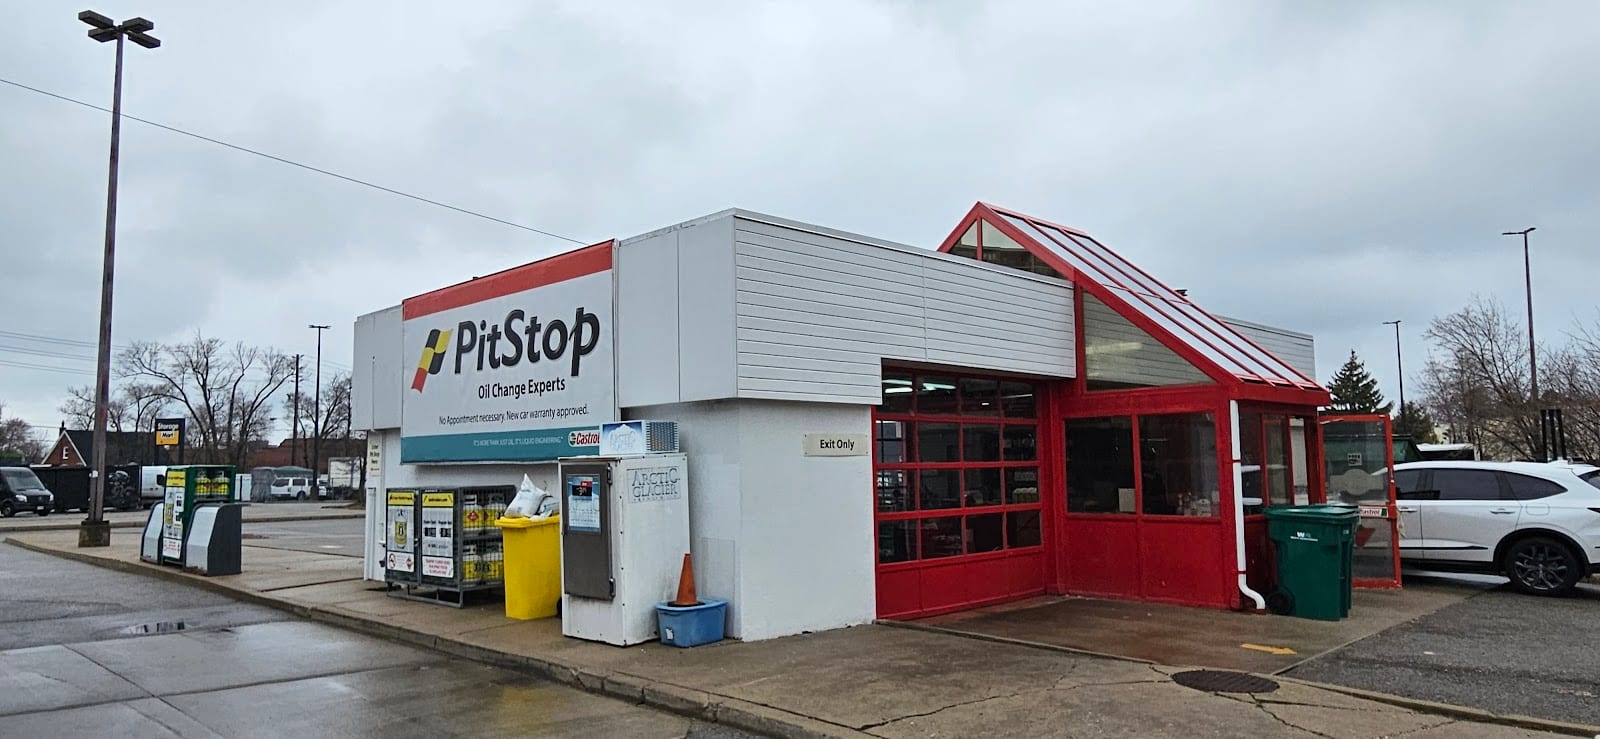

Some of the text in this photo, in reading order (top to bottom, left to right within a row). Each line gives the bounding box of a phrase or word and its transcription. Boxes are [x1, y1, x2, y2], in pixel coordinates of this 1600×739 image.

[454, 307, 600, 377] PitStop
[478, 377, 566, 400] Oil Change Experts
[439, 415, 446, 425] No
[447, 415, 479, 426] Appointment
[506, 410, 519, 420] New
[520, 410, 529, 420] car
[530, 408, 556, 420] warranty
[556, 404, 589, 419] approved.
[157, 422, 179, 431] Storage
[820, 439, 855, 451] Exit Only
[631, 467, 680, 486] ARCTIC
[632, 484, 678, 498] GLACIER
